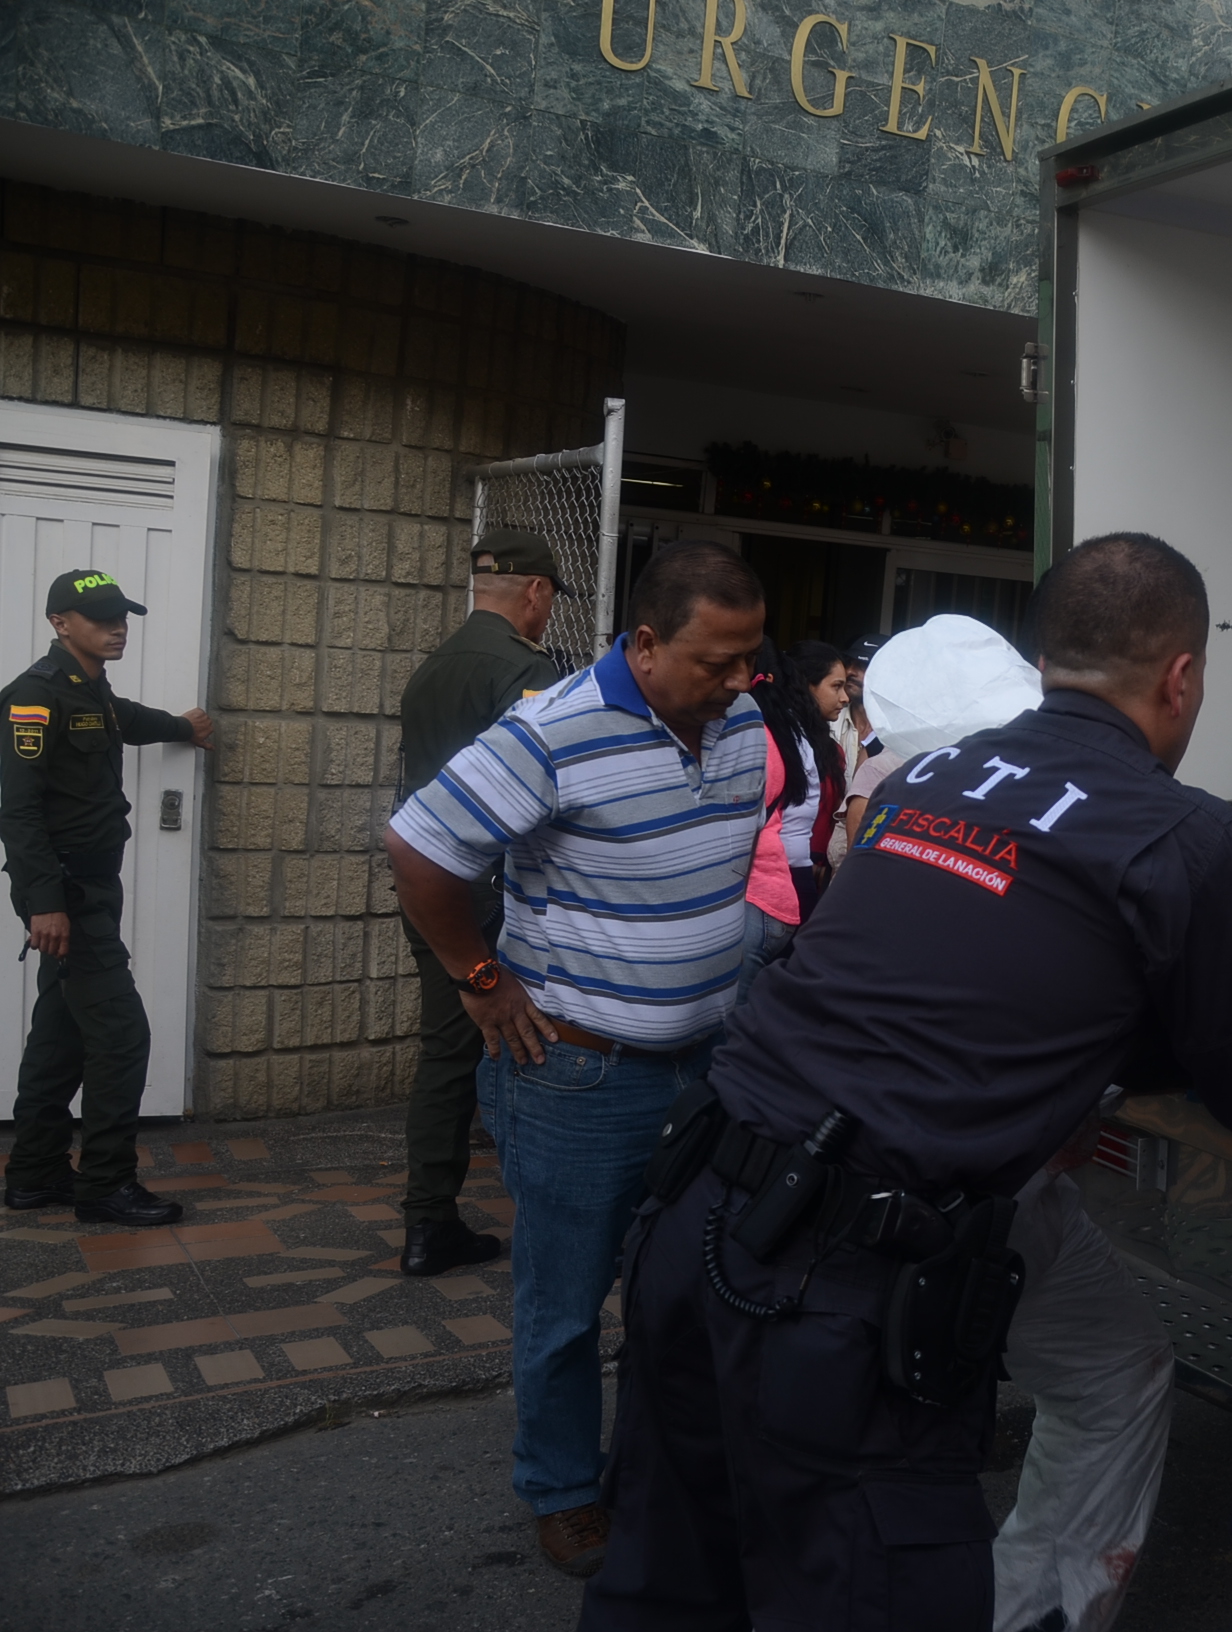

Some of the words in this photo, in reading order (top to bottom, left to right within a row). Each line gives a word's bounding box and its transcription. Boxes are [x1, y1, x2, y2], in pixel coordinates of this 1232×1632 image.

[598, 0, 1151, 162] URGENC
[905, 747, 1088, 832] CTI
[879, 837, 923, 858] GENERAL
[921, 848, 941, 862] DE
[937, 853, 955, 869] LA
[953, 859, 1007, 892] NACIÓN
[890, 808, 1019, 871] FISCALÍA
